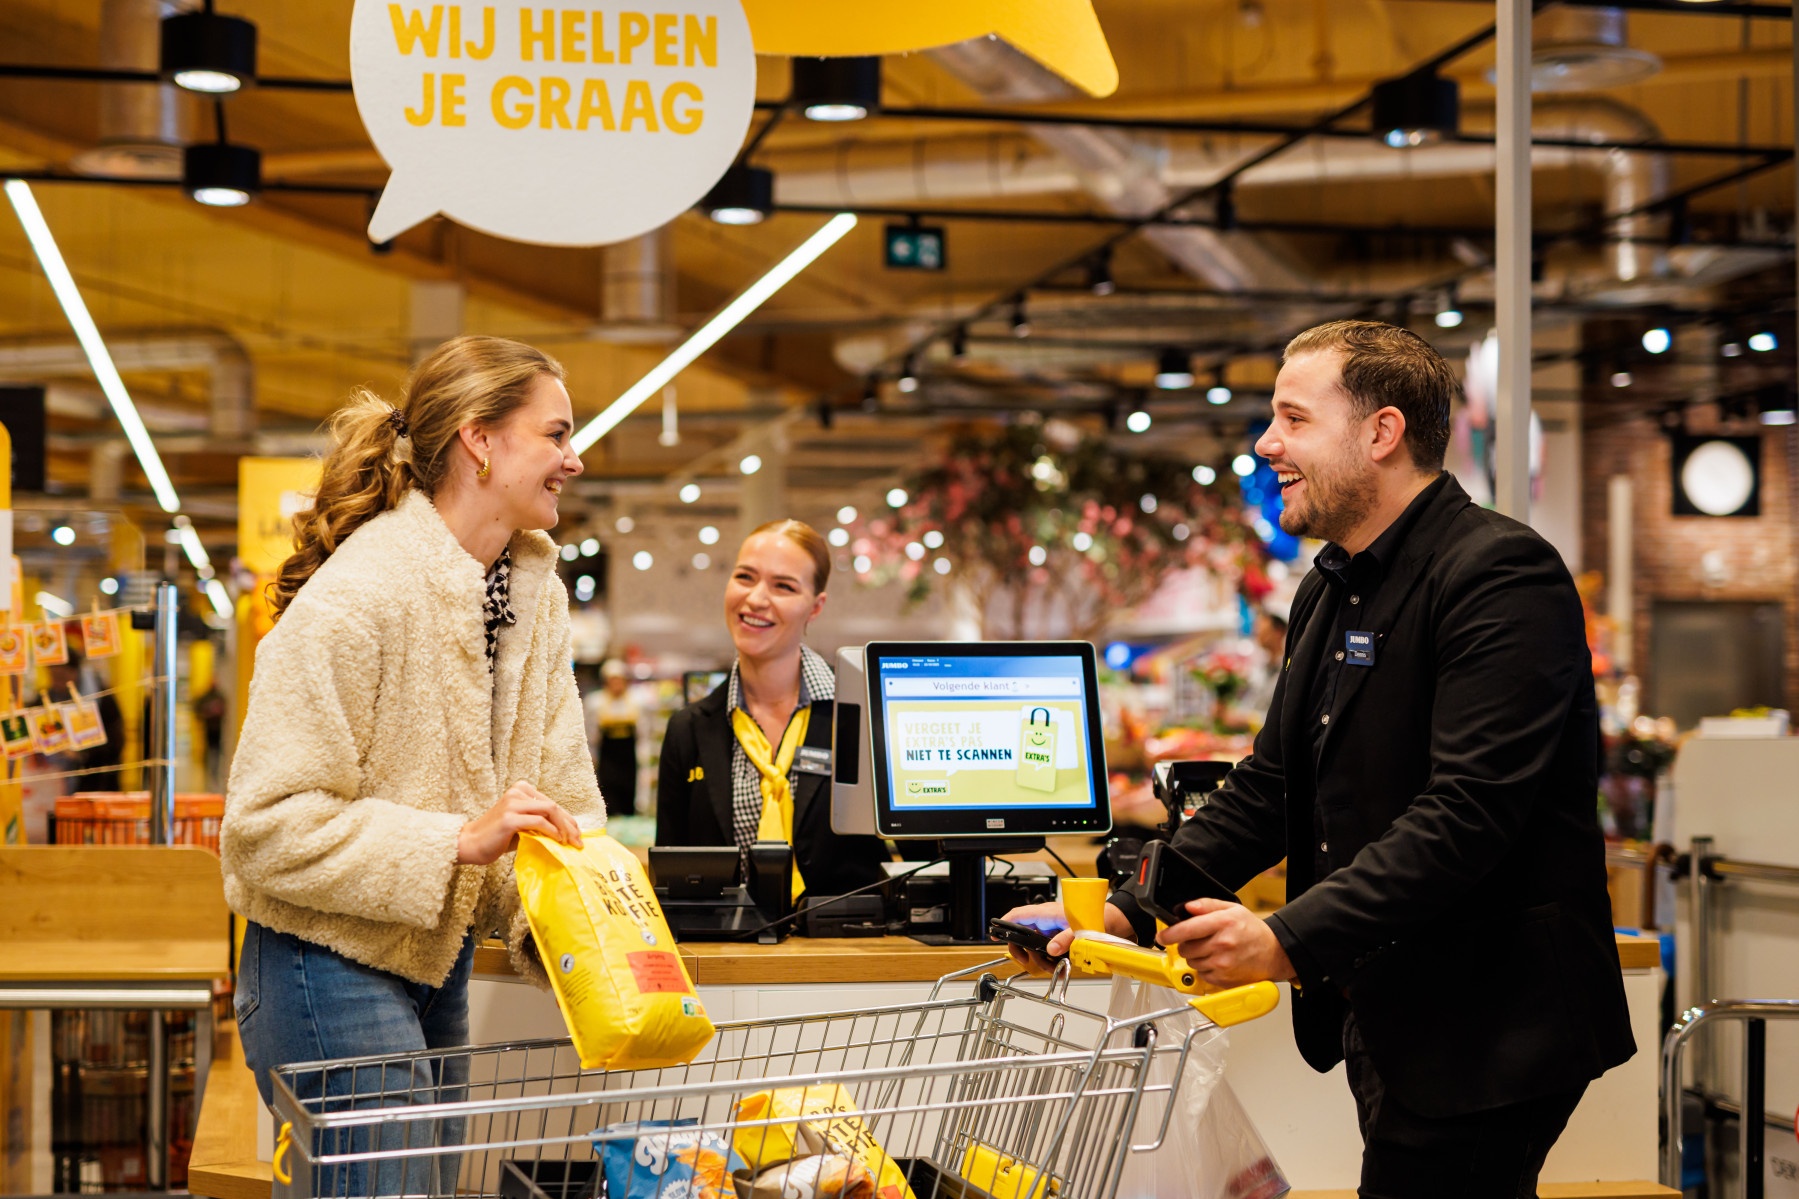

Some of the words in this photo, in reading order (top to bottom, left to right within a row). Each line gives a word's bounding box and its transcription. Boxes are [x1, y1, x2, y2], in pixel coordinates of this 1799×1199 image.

[388, 3, 496, 60] WIJ
[520, 7, 718, 68] HELPEN
[404, 73, 466, 128] JE
[490, 75, 705, 135] GRAAG
[1350, 635, 1369, 645] JUMBO
[933, 681, 981, 693] Volgende
[983, 681, 1009, 691] klant
[905, 722, 960, 735] VERGEET
[968, 722, 983, 734] JE
[905, 736, 957, 748] EXTRA'S
[961, 736, 984, 748] PAS
[906, 749, 932, 761] NIET
[938, 749, 951, 761] TE
[957, 749, 1013, 761] SCANNEN
[1025, 752, 1050, 763] EXTRA'S
